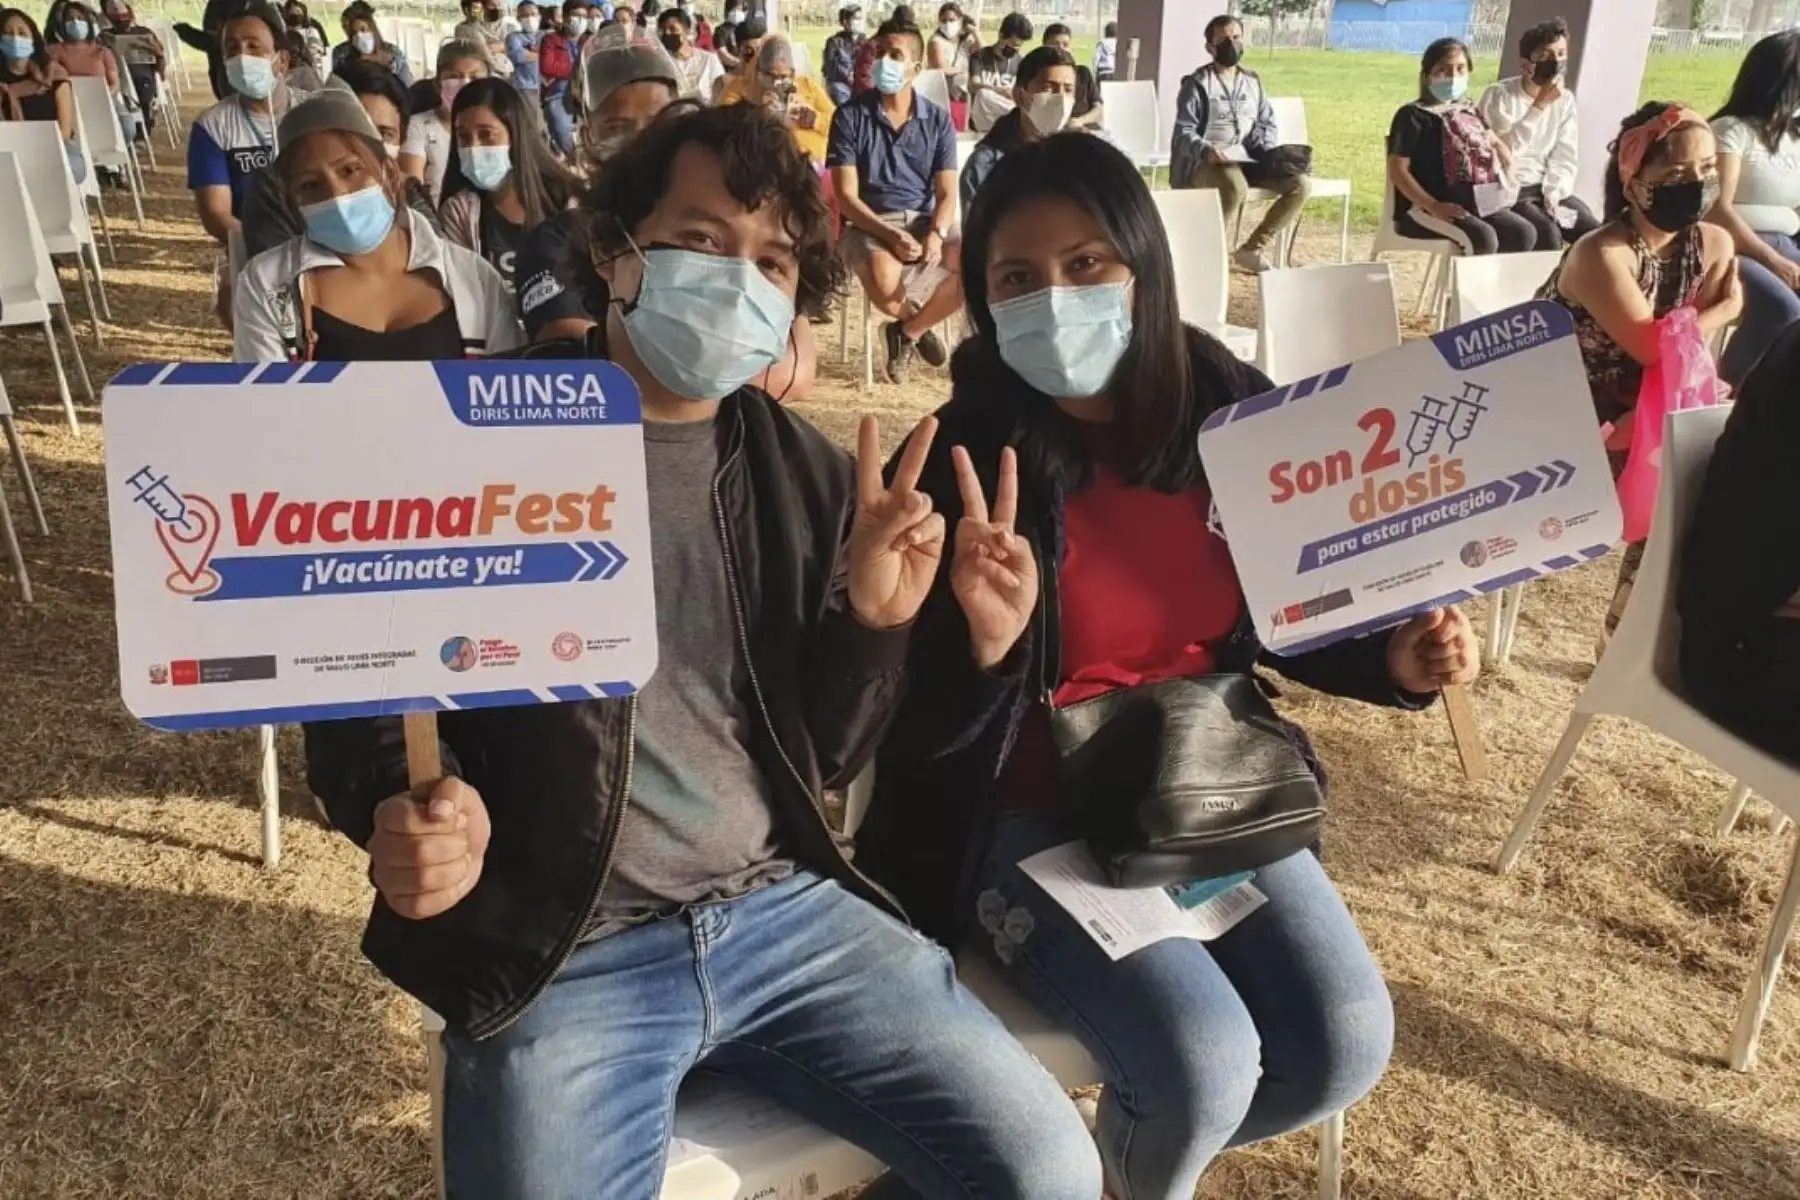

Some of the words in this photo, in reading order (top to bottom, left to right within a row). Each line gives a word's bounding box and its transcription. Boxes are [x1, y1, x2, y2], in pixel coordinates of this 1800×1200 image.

[1454, 309, 1548, 356] MINSA
[468, 374, 607, 406] MINSA
[470, 407, 511, 421] DIRIS
[514, 407, 553, 420] LIMA
[557, 405, 608, 419] NORTE
[1268, 450, 1353, 504] Son
[1357, 407, 1401, 475] 2
[230, 484, 617, 547] VacunaFest
[1348, 454, 1466, 524] dosis
[1317, 536, 1357, 565] para
[1361, 519, 1409, 545] estar
[1411, 489, 1497, 534] protegido
[302, 553, 469, 592] ¡Vacúnate
[473, 549, 523, 585] ya!
